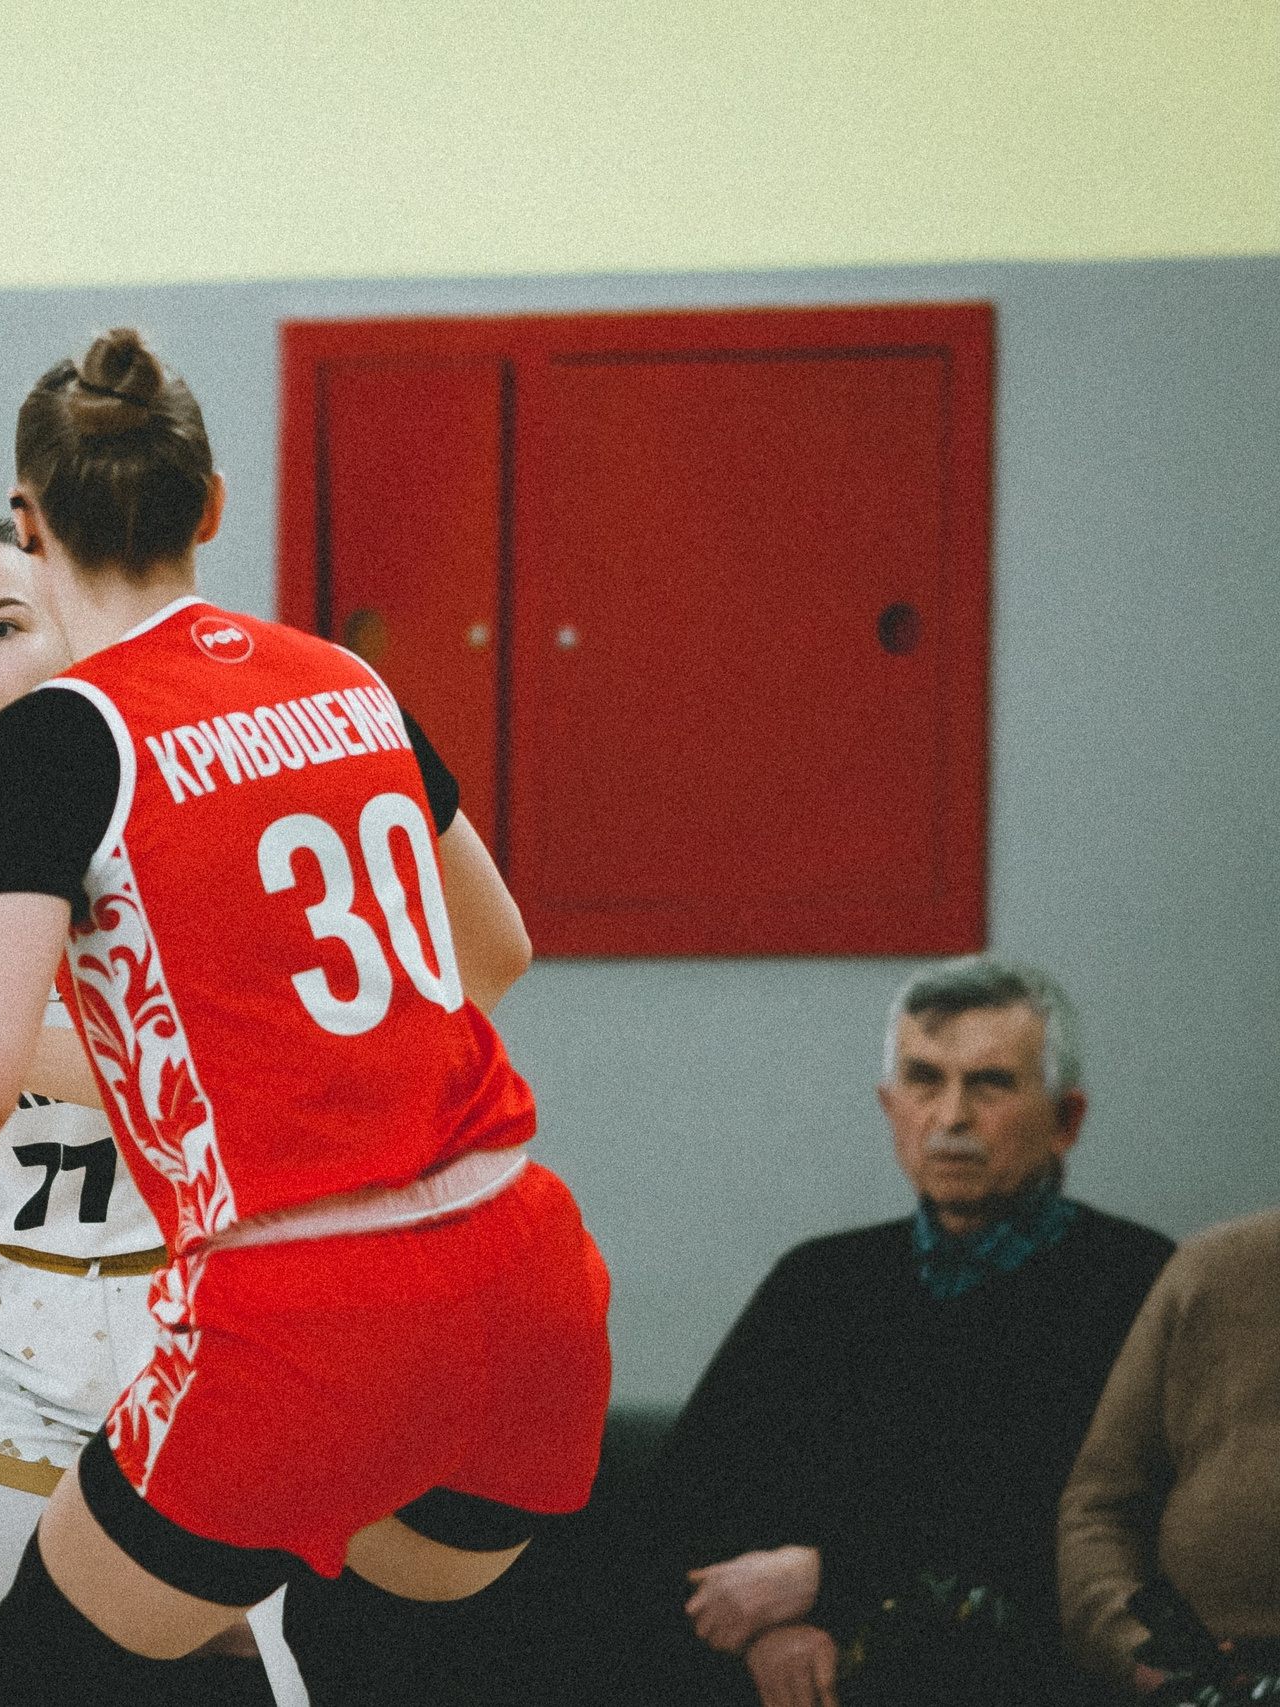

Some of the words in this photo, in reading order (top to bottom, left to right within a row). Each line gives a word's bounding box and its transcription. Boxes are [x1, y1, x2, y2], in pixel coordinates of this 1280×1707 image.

[145, 686, 412, 804] КРИВОШЕИН
[257, 792, 464, 1036] 30
[11, 1136, 118, 1232] 77
